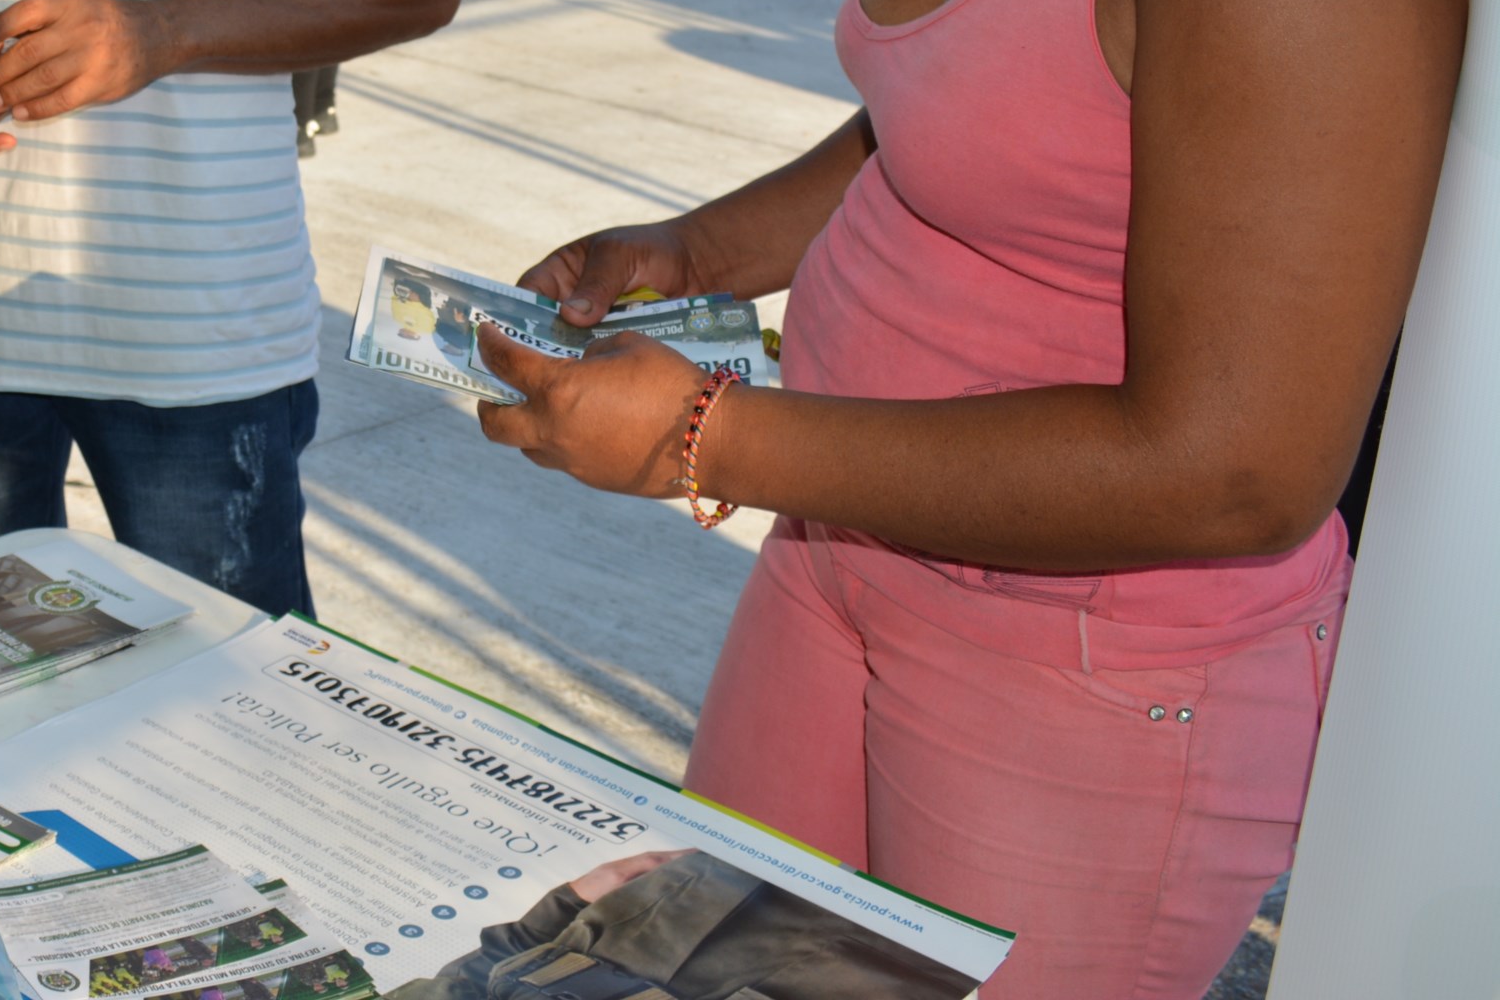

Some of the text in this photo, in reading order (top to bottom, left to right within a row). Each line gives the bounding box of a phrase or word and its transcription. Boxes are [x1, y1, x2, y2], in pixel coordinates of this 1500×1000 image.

[643, 323, 684, 338] POLICÍA
[468, 718, 521, 745] Colombia
[122, 738, 175, 768] prestación
[518, 741, 559, 763] Policía
[93, 755, 134, 778] servicio
[211, 753, 267, 784] posibilidad
[218, 690, 558, 862] ¡Que orgullo ser Policía!
[555, 759, 635, 799] Incorporación
[143, 782, 180, 803] tiempo
[179, 770, 221, 793] durante
[217, 789, 261, 814] gratuita
[467, 781, 596, 845] Mayor información
[185, 806, 229, 832] durante
[306, 805, 343, 827] militar
[255, 810, 325, 849] odontológica
[340, 824, 385, 848] servicio
[224, 829, 272, 856] mensual
[267, 853, 329, 888] económica
[302, 858, 324, 871] con
[327, 851, 372, 876] médica
[372, 862, 419, 889] servicio
[395, 853, 444, 881] finalizar
[651, 803, 926, 934] www.policia.gov.co/direccion/incorporacion
[366, 873, 428, 908] Asistencia
[415, 886, 439, 901] del
[440, 877, 460, 889] Al
[220, 905, 252, 922] DEFINA
[322, 888, 394, 927] Bonificación
[131, 929, 166, 945] MILITAR
[165, 917, 210, 938] SITUACIÓN
[33, 945, 76, 966] NACIONAL
[75, 941, 108, 959] POLICÍA
[282, 941, 321, 966] DEFINA
[190, 967, 229, 986] MILITAR
[226, 951, 275, 981] SITUACIÓN
